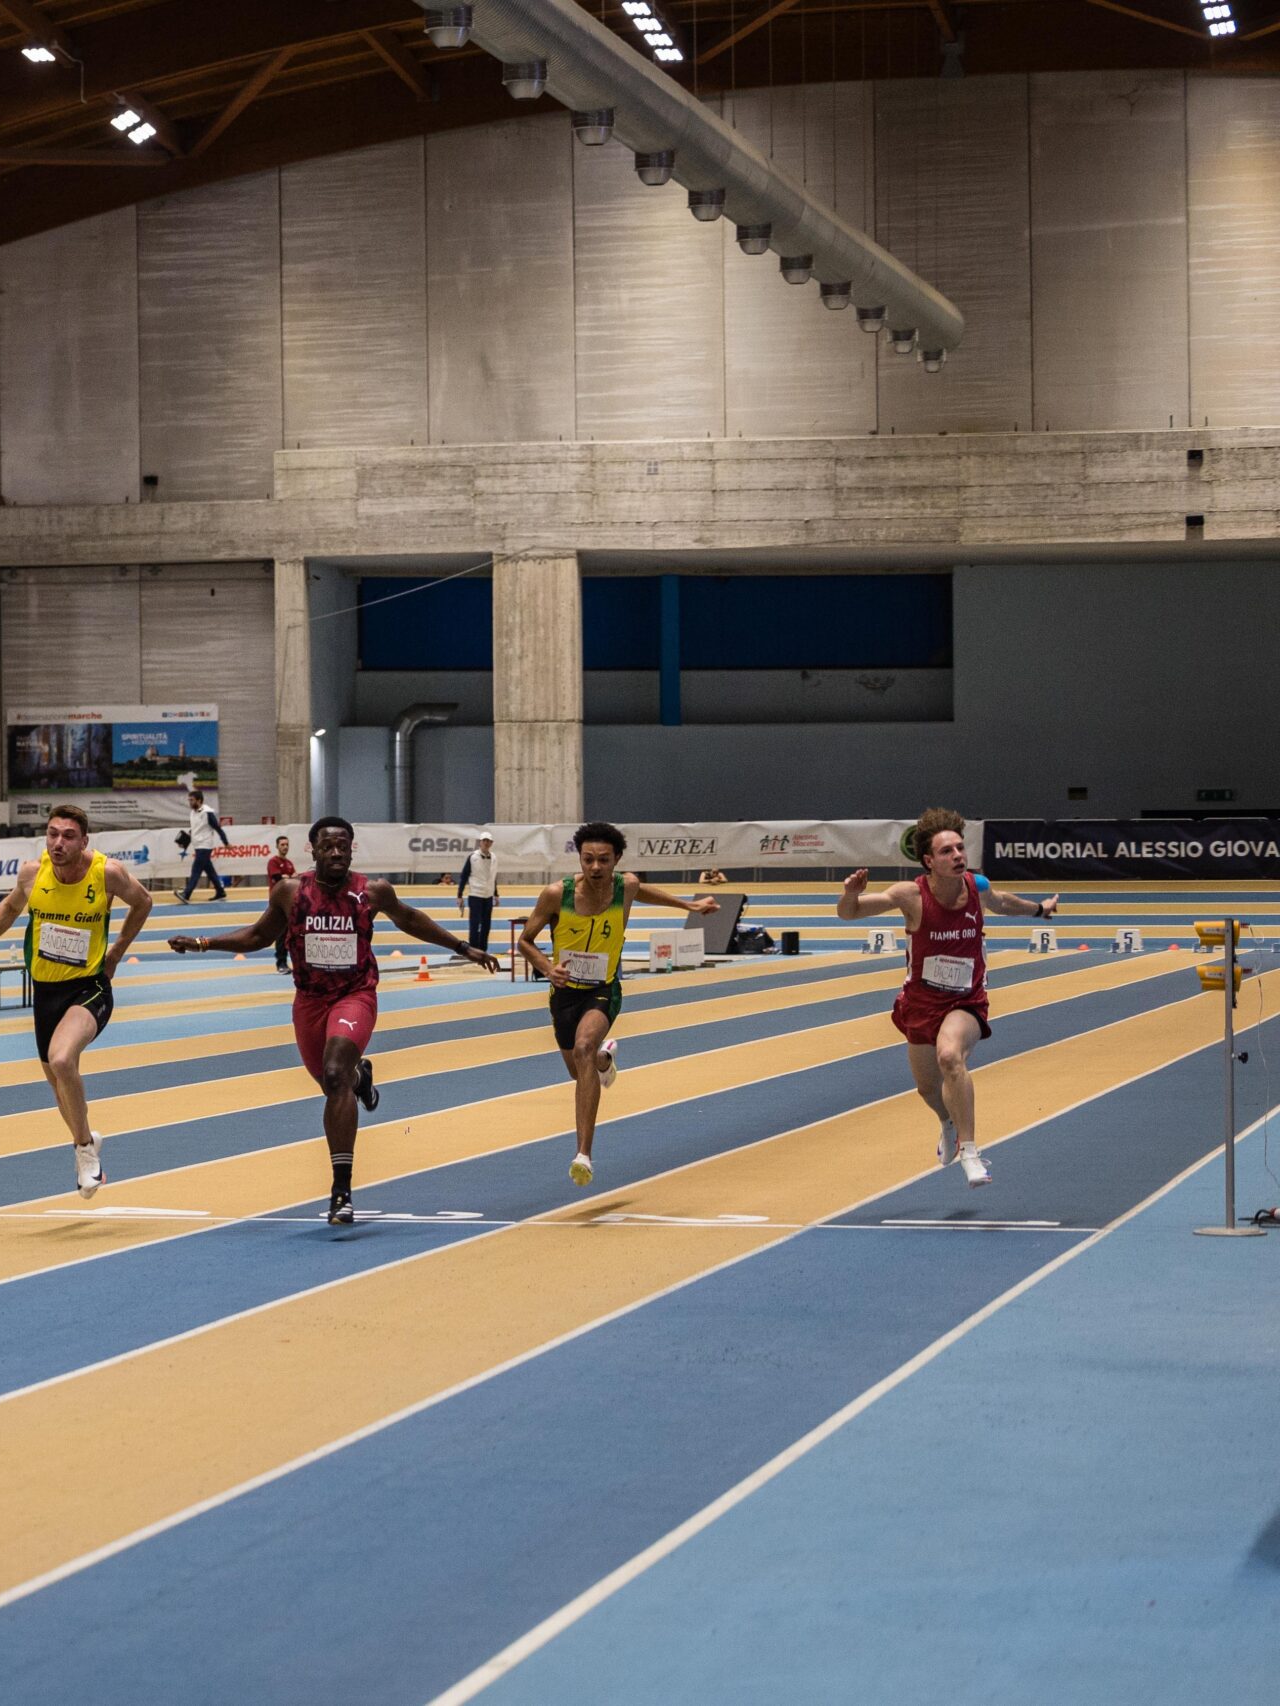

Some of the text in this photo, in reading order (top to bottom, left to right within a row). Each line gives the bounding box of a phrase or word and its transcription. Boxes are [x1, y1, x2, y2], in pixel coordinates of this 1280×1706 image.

[640, 838, 717, 855] NEREA
[994, 840, 1280, 859] MEMORIAL ALESSIO GIOVA
[33, 909, 71, 922] Fiamme
[305, 916, 354, 931] POLIZIA
[875, 933, 884, 946] 8
[930, 928, 976, 940] FIAMME ORO
[1041, 932, 1050, 944] 6
[1124, 932, 1133, 944] 5
[306, 943, 353, 960] BONDAOGO
